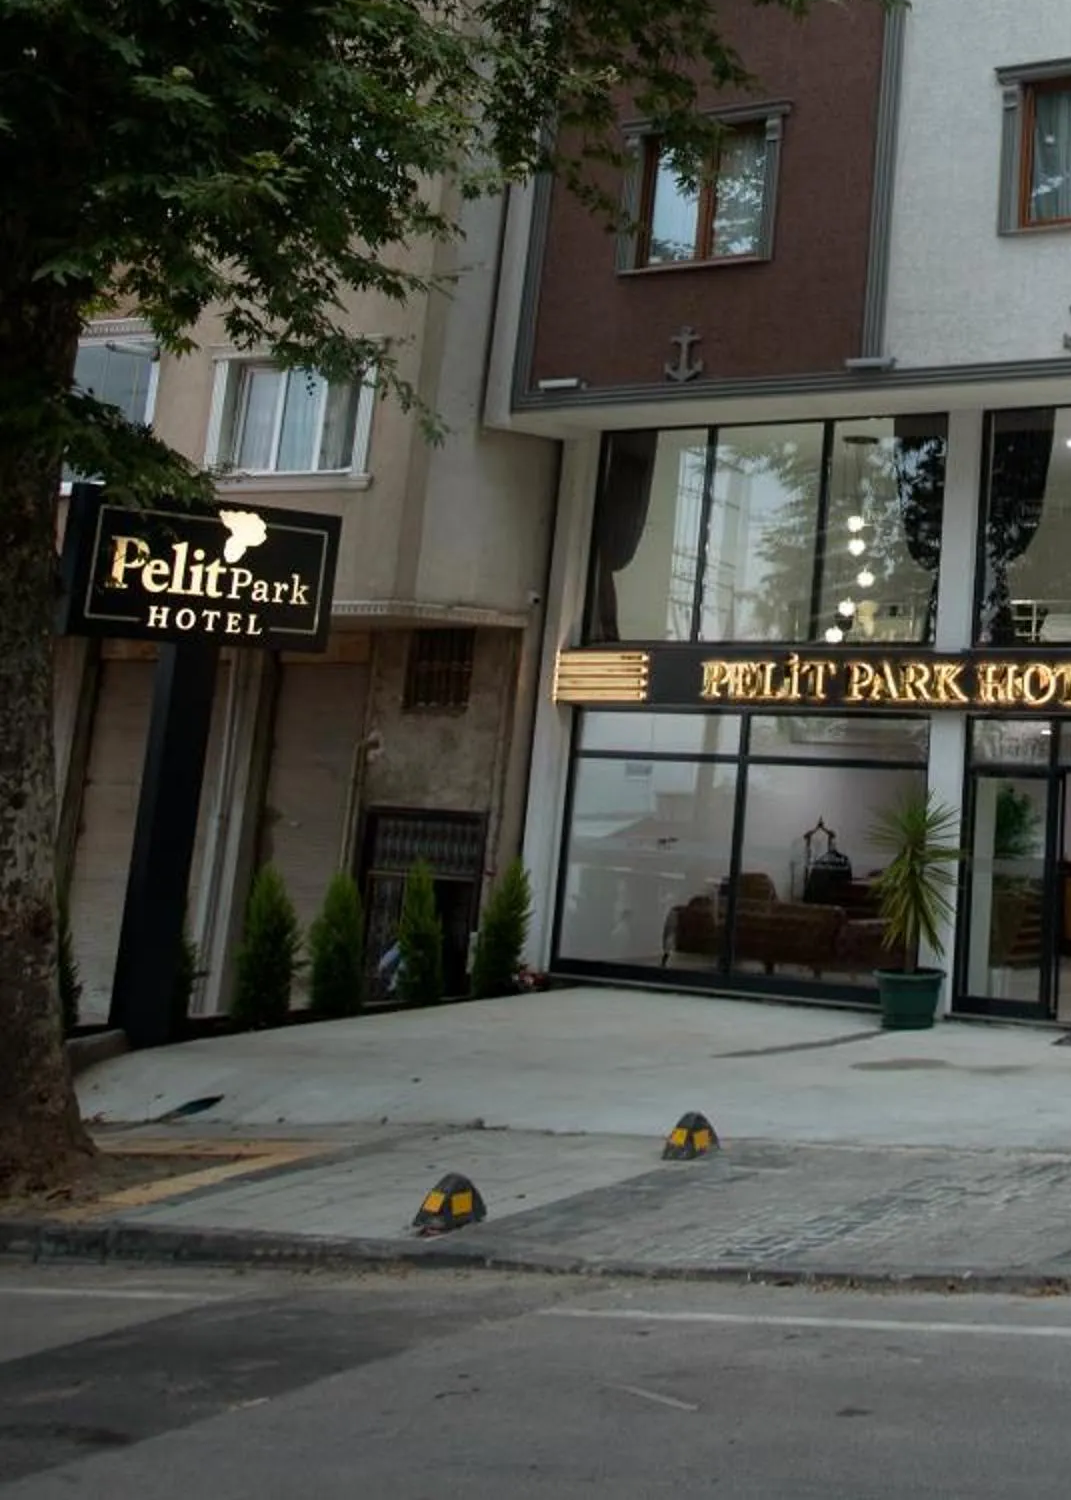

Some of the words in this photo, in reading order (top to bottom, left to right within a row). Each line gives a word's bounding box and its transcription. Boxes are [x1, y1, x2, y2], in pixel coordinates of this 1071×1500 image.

[104, 535, 227, 598] Pelit
[226, 567, 310, 606] Park
[146, 605, 263, 636] HOTEL
[844, 661, 969, 702] PARK
